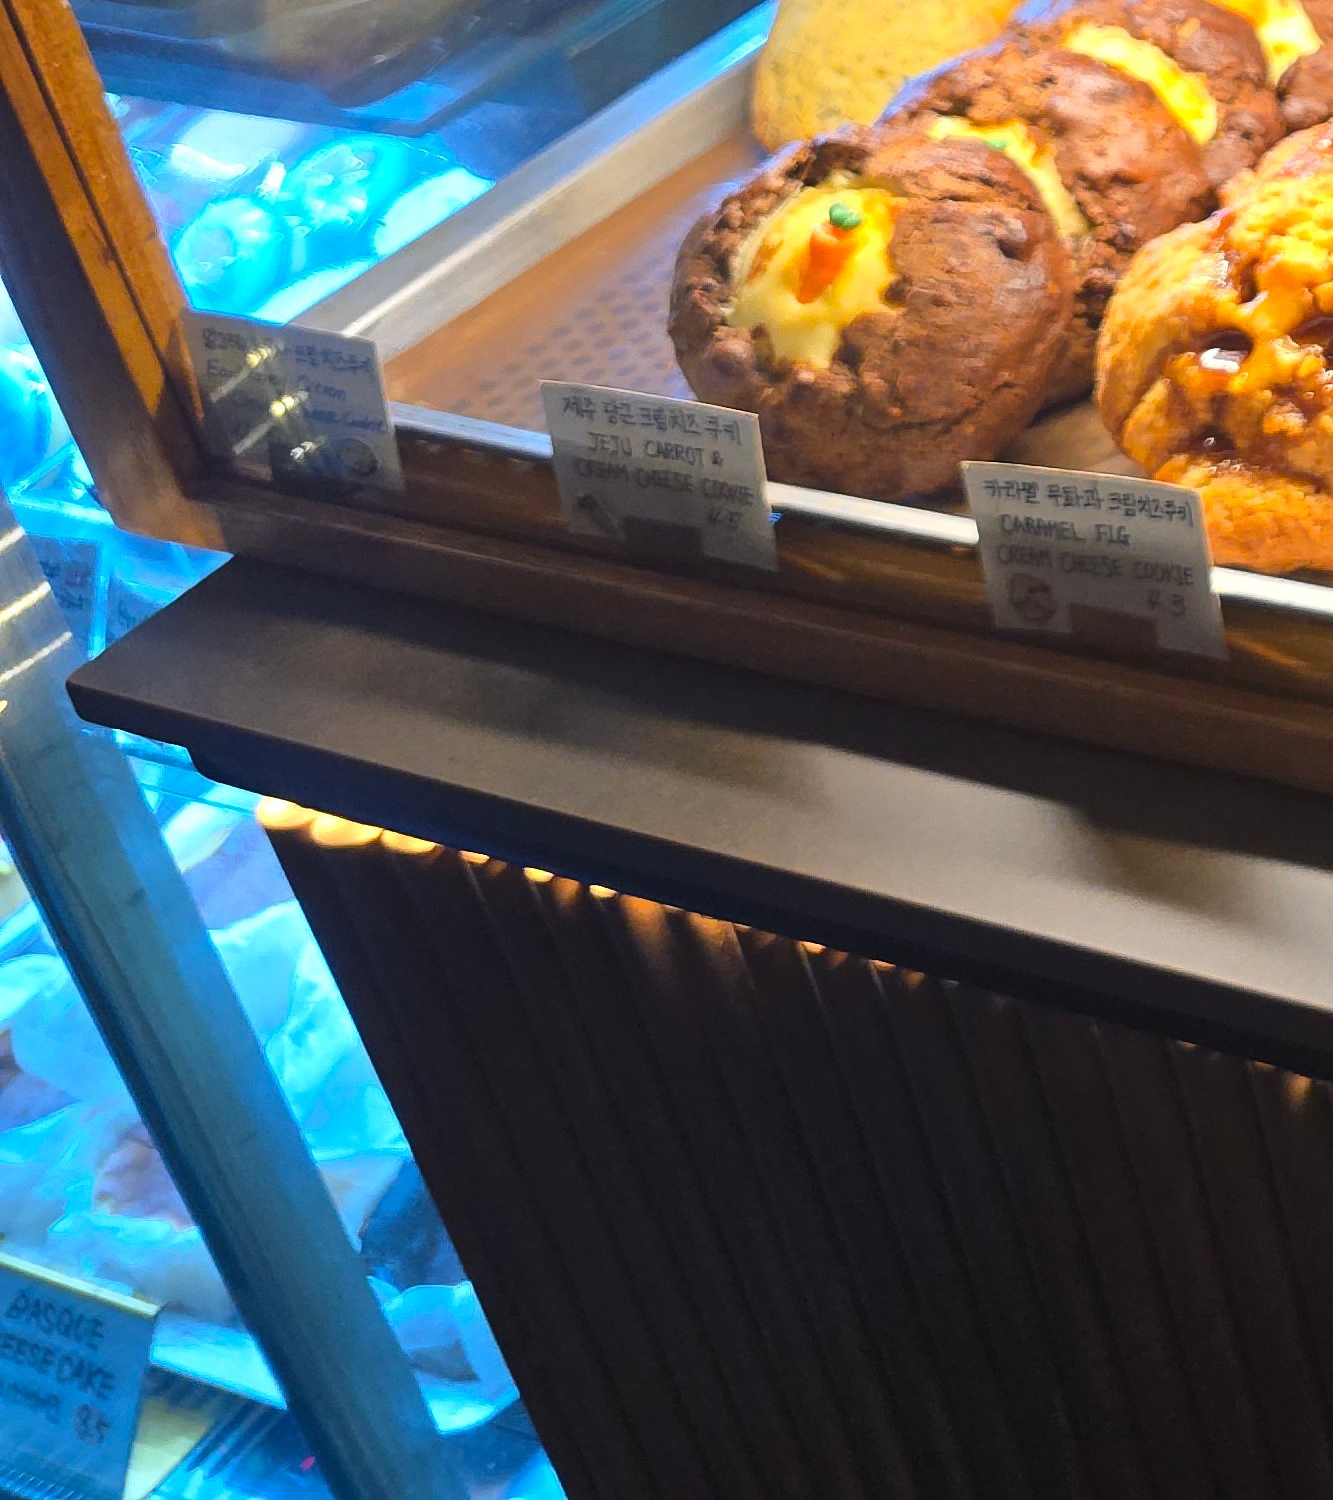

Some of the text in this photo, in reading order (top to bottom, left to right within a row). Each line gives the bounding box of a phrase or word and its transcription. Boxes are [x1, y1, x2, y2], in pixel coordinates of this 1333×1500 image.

[587, 431, 633, 457] JEJU
[644, 439, 704, 467] CARROT
[1001, 513, 1131, 546] CARAMEL FIG
[995, 544, 1194, 586] CREAM CHEESE COOKIE
[56, 1353, 116, 1400] CAKE
